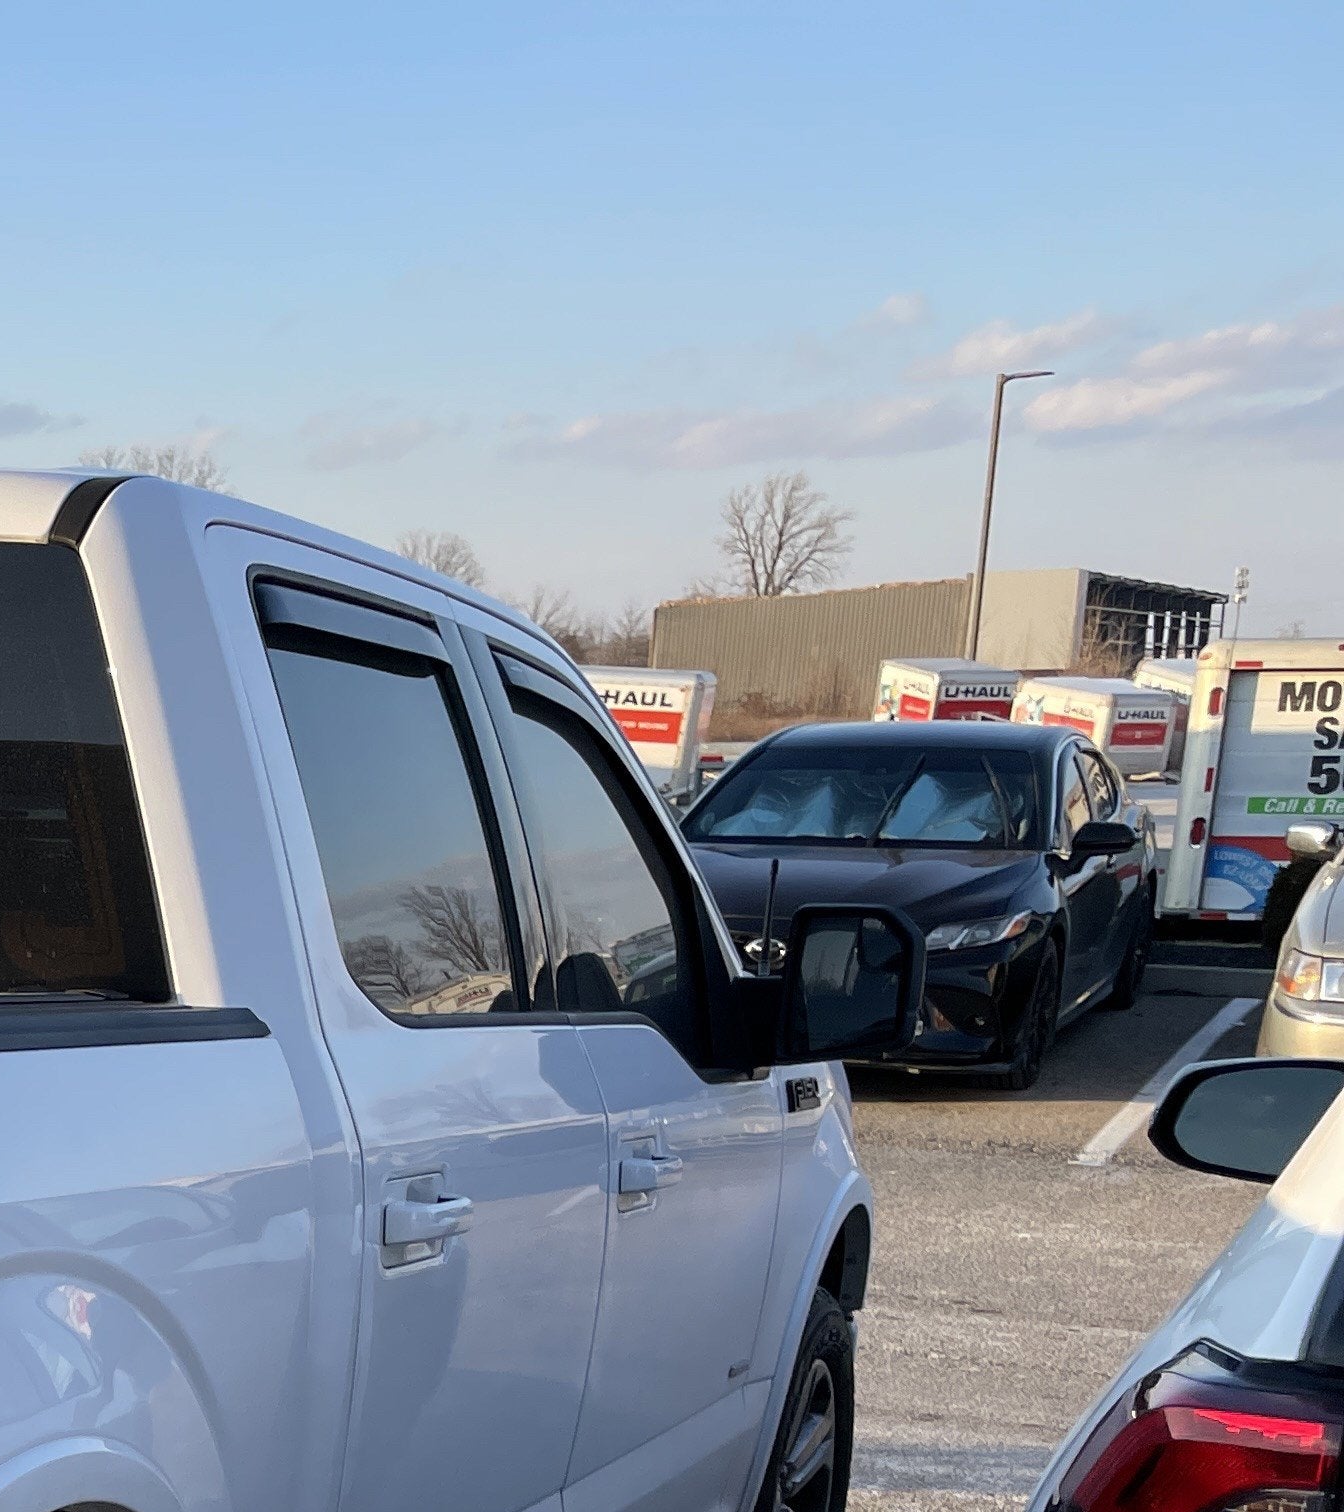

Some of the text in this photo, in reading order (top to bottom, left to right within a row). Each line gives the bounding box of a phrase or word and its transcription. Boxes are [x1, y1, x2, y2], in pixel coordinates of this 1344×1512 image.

[599, 689, 673, 707] -HAUL
[944, 686, 1011, 698] U-HAUL
[1313, 716, 1344, 750] S
[1306, 755, 1344, 796] 5
[1264, 798, 1297, 814] Call
[1303, 799, 1316, 814] &
